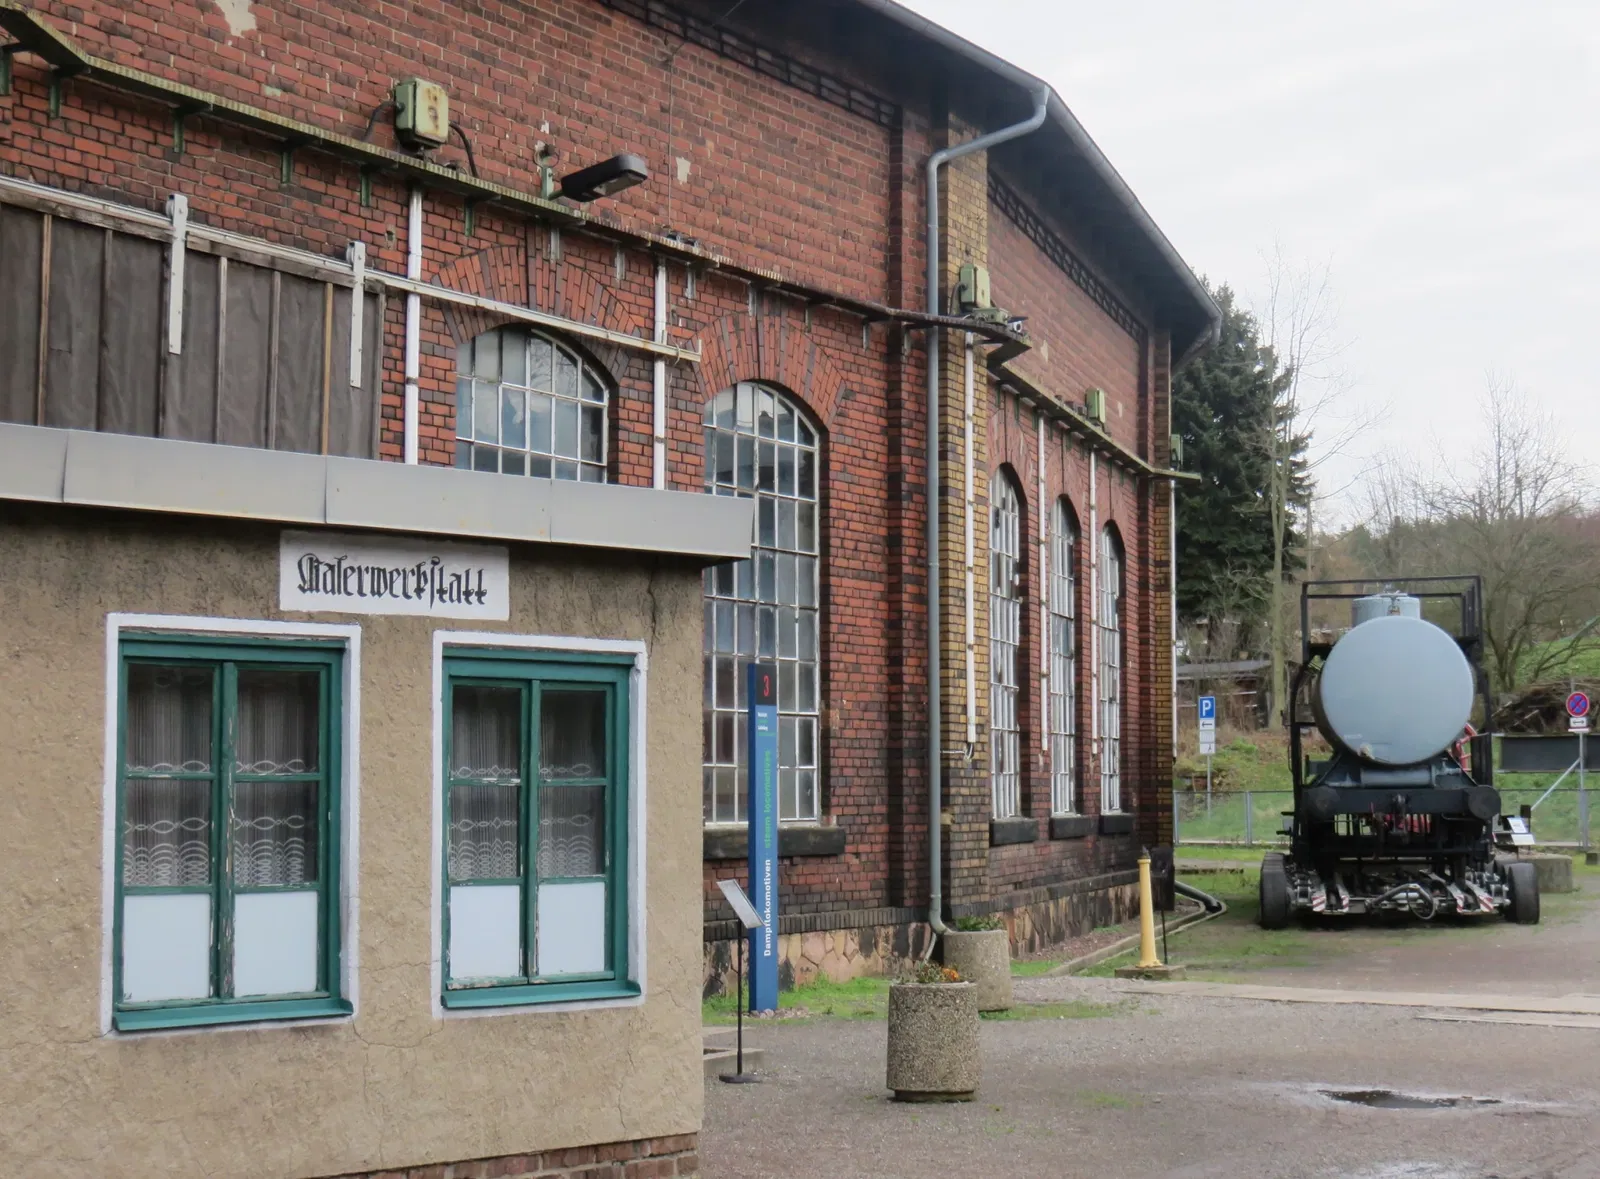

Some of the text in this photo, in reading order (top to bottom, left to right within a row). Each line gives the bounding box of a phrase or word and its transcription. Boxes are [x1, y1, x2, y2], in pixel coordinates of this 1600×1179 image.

[297, 553, 488, 610] Malerwerkstatt
[763, 675, 771, 697] 3
[1202, 699, 1212, 717] P
[763, 859, 773, 957] Dampflokomotiven
